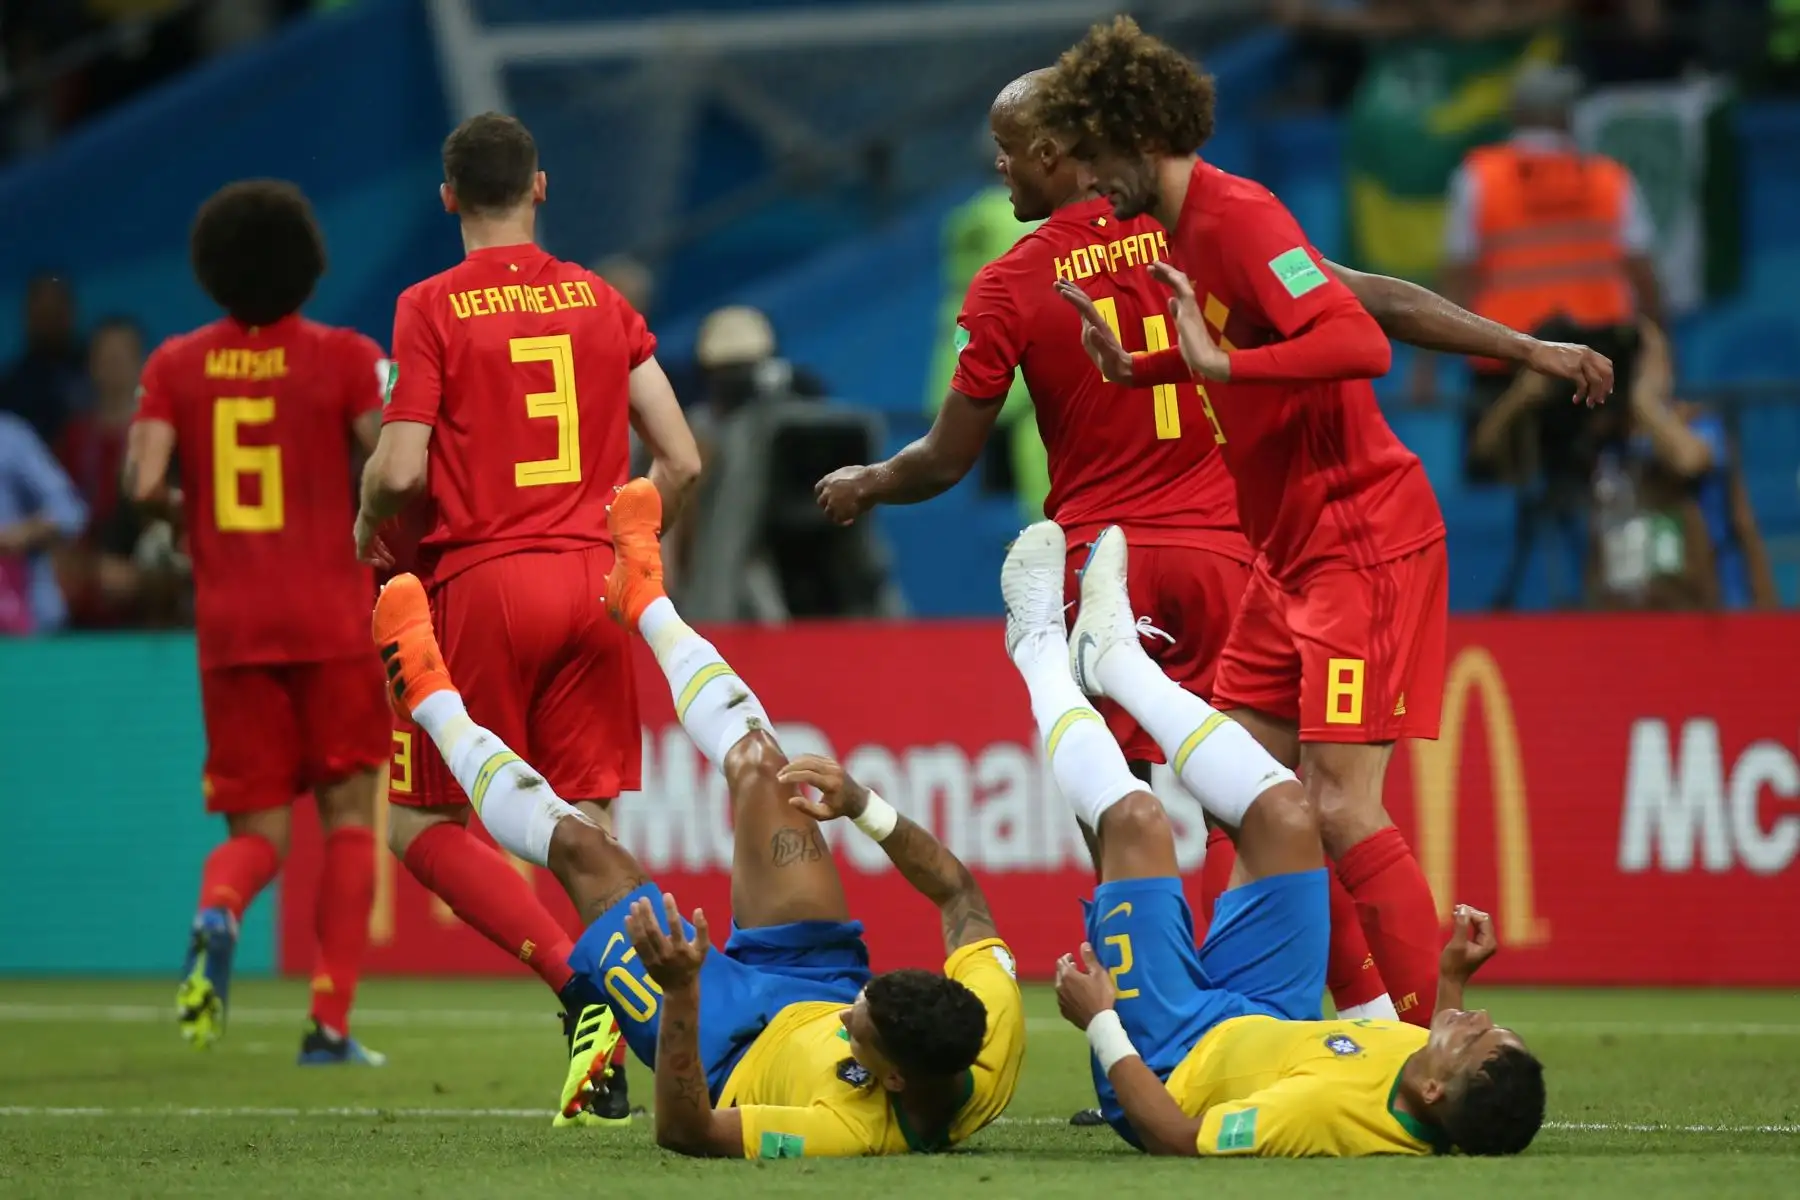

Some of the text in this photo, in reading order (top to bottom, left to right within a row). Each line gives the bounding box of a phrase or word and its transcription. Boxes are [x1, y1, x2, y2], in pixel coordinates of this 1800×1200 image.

[450, 281, 597, 319] VERMAELEN
[509, 334, 581, 487] 3
[213, 397, 284, 531] 6
[1326, 658, 1365, 724] 8
[391, 729, 412, 792] 3
[1104, 933, 1140, 999] 2
